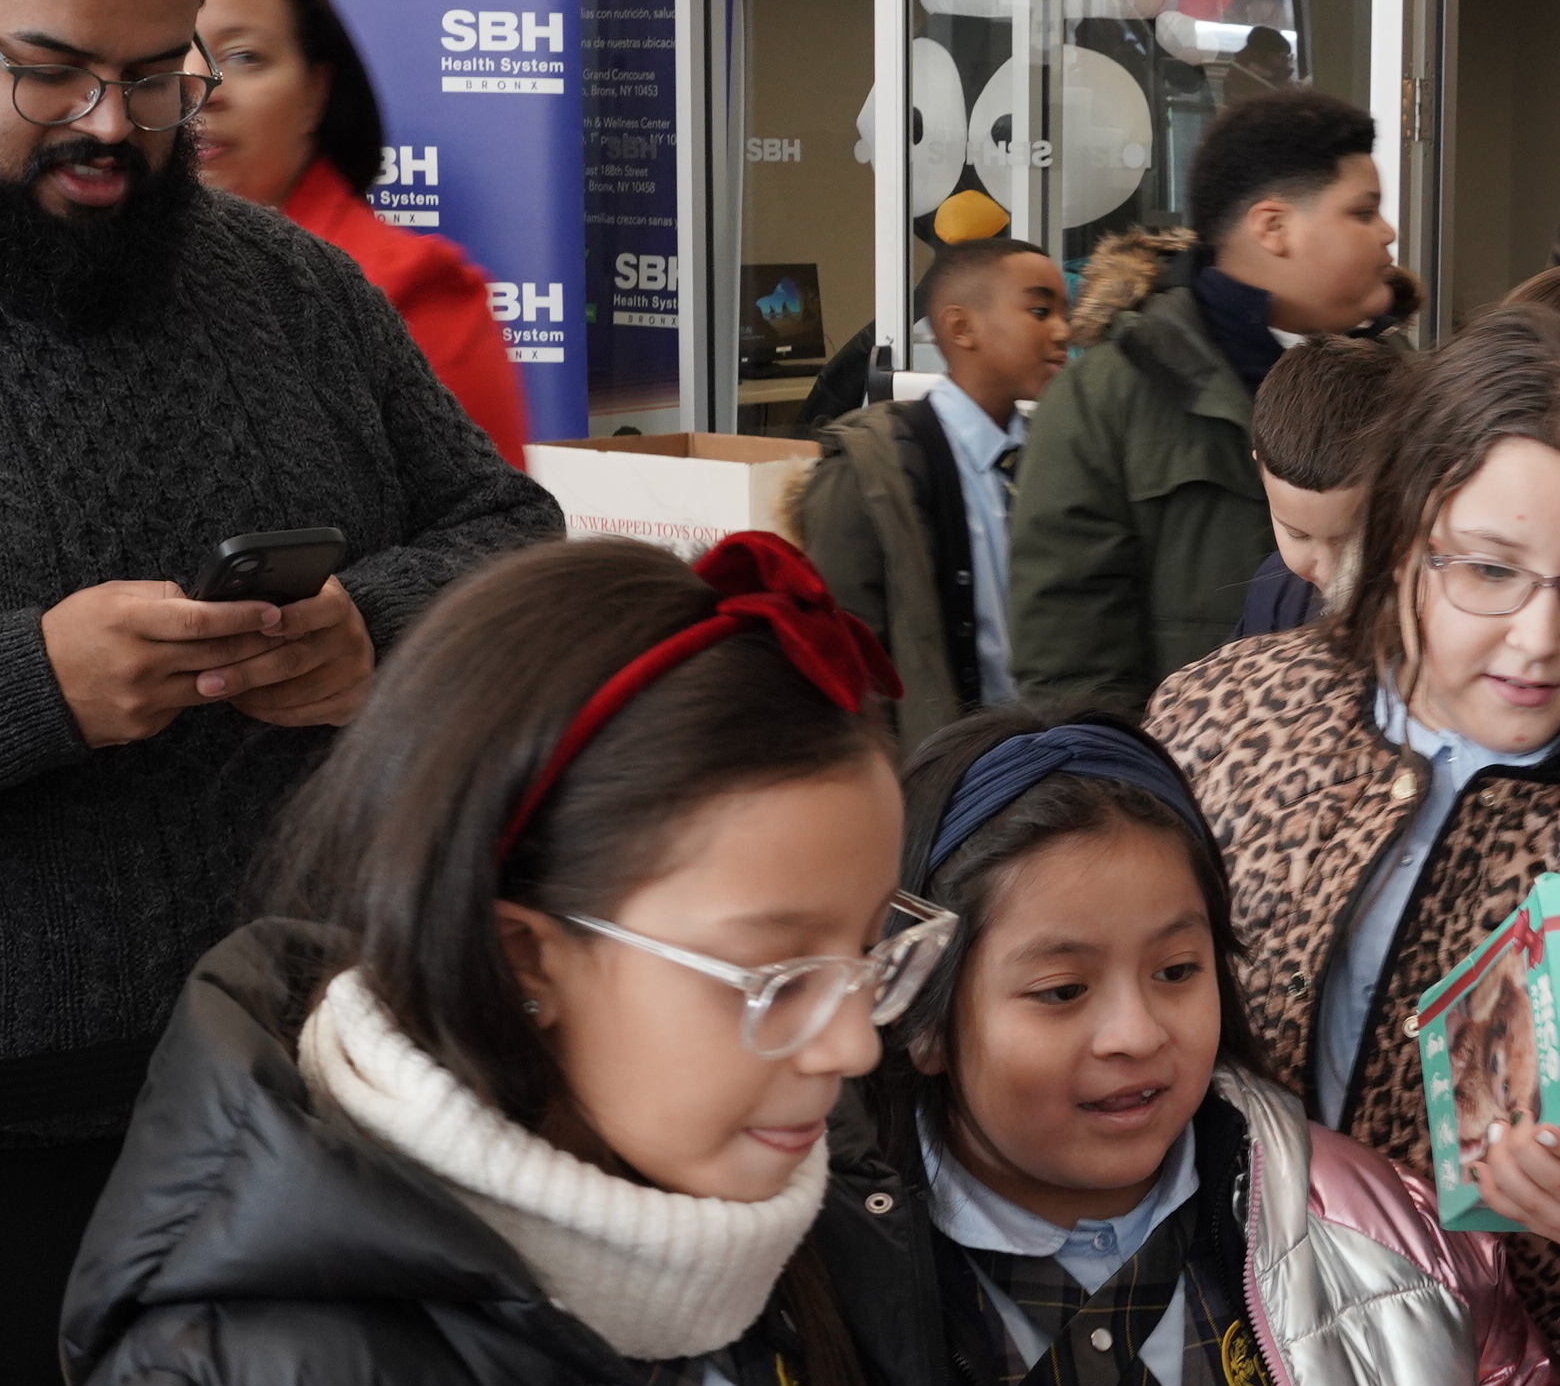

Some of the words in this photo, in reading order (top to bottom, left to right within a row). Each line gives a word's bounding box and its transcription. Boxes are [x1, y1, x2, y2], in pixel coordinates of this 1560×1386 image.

[440, 9, 564, 52] SBH
[607, 39, 641, 48] nuestras
[441, 57, 495, 72] Health
[500, 58, 564, 74] System
[583, 68, 610, 81] Grand
[611, 68, 655, 81] Concourse
[465, 80, 538, 91] BRONX
[591, 85, 618, 98] Bronx,
[619, 85, 632, 97] NY
[634, 85, 658, 97] 10453
[603, 117, 638, 129] Wellness
[640, 117, 671, 129] Center
[746, 137, 801, 162] SBH
[601, 165, 623, 176] 188th
[624, 165, 648, 177] Street
[589, 180, 615, 193] Bronx,
[617, 181, 630, 192] NY
[632, 181, 656, 193] 10458
[380, 192, 439, 206] System
[616, 216, 647, 226] crezcan
[648, 217, 673, 227] sanas
[613, 294, 648, 307] Health
[502, 329, 564, 342] System
[569, 514, 652, 537] UNWRAPPED
[654, 521, 690, 540] TOYS
